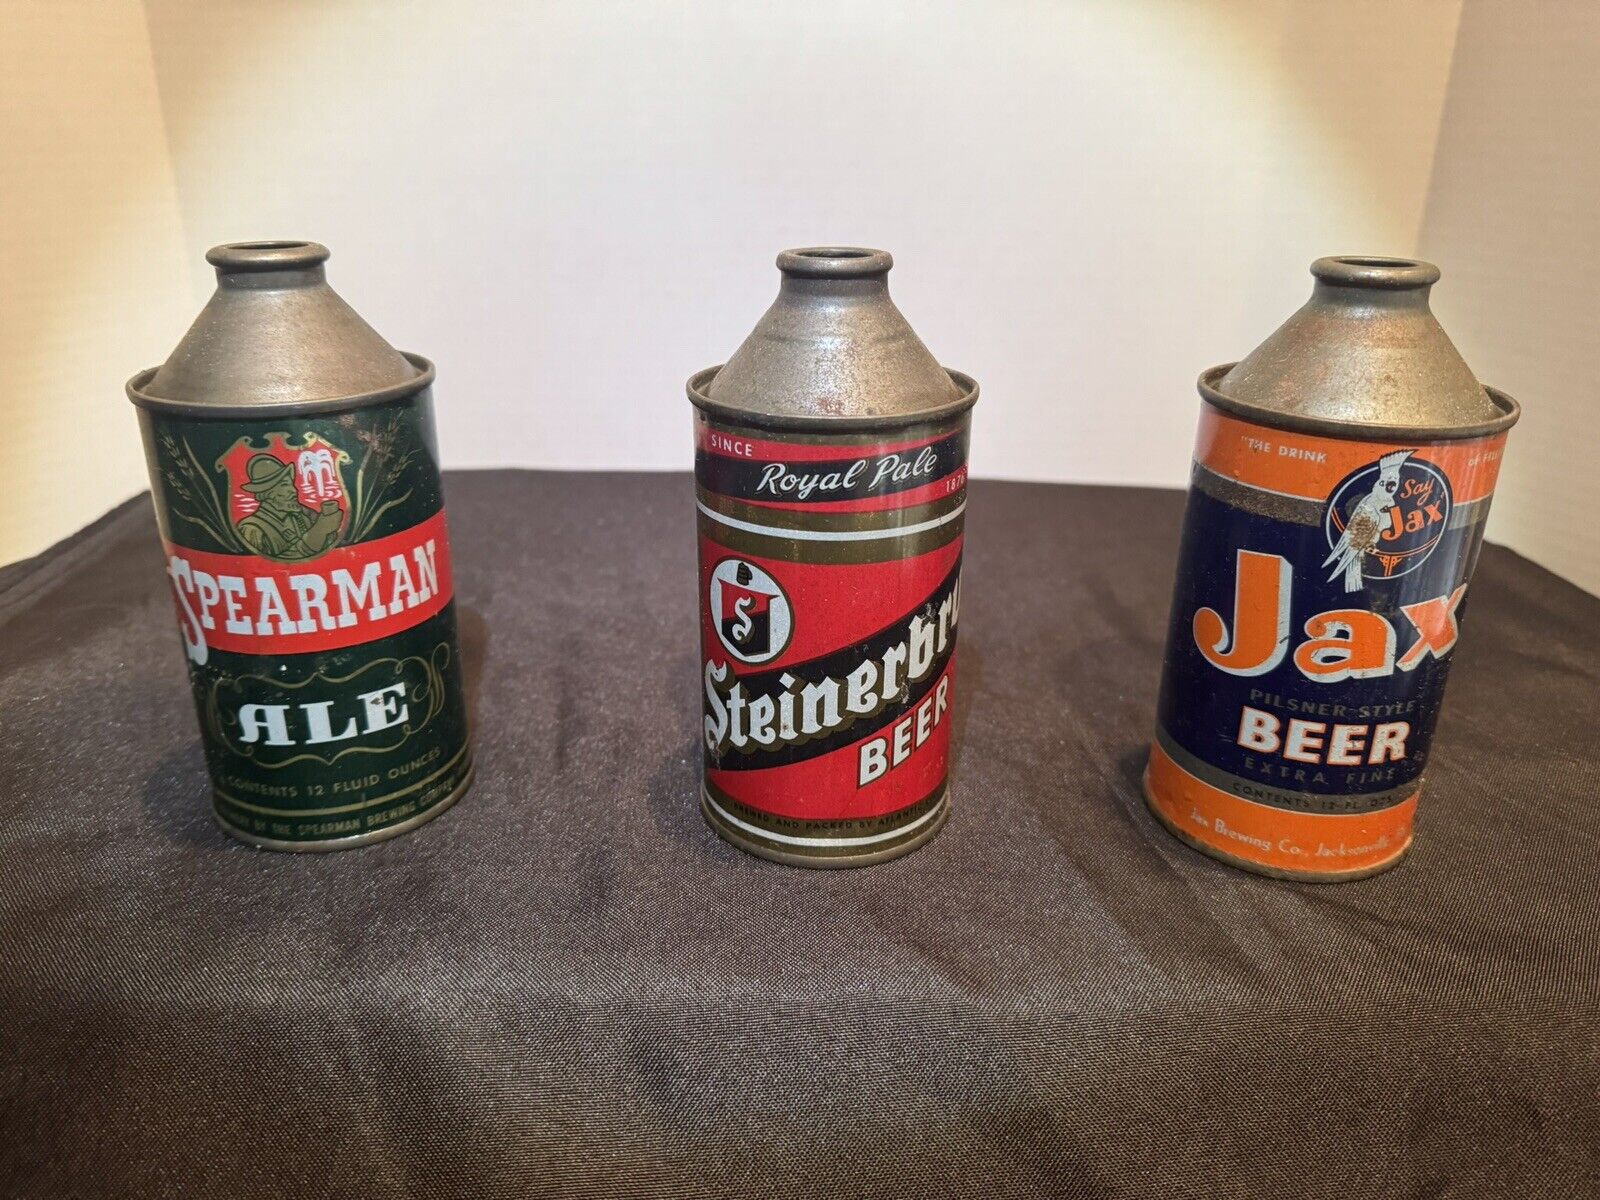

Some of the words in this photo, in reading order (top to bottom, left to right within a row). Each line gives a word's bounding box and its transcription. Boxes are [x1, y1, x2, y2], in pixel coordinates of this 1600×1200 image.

[711, 435, 753, 458] SINCE
[1278, 445, 1328, 465] DRINK
[756, 459, 868, 500] Royal
[868, 446, 938, 492] Pale
[1400, 477, 1436, 506] Say
[167, 538, 440, 667] SPEARMAN
[1193, 548, 1468, 684] Jax
[238, 682, 409, 747] ALE
[858, 675, 949, 787] BEER
[1236, 704, 1412, 766] BEER
[306, 784, 326, 797] 12
[332, 774, 380, 794] FLUID
[387, 746, 441, 780] OUNCES
[1244, 757, 1327, 785] EXTRA
[1345, 768, 1397, 785] FINE
[1233, 782, 1310, 808] CONTENTS
[775, 819, 800, 829] AND
[806, 821, 853, 830] PACKED
[1215, 817, 1273, 853] Brewing
